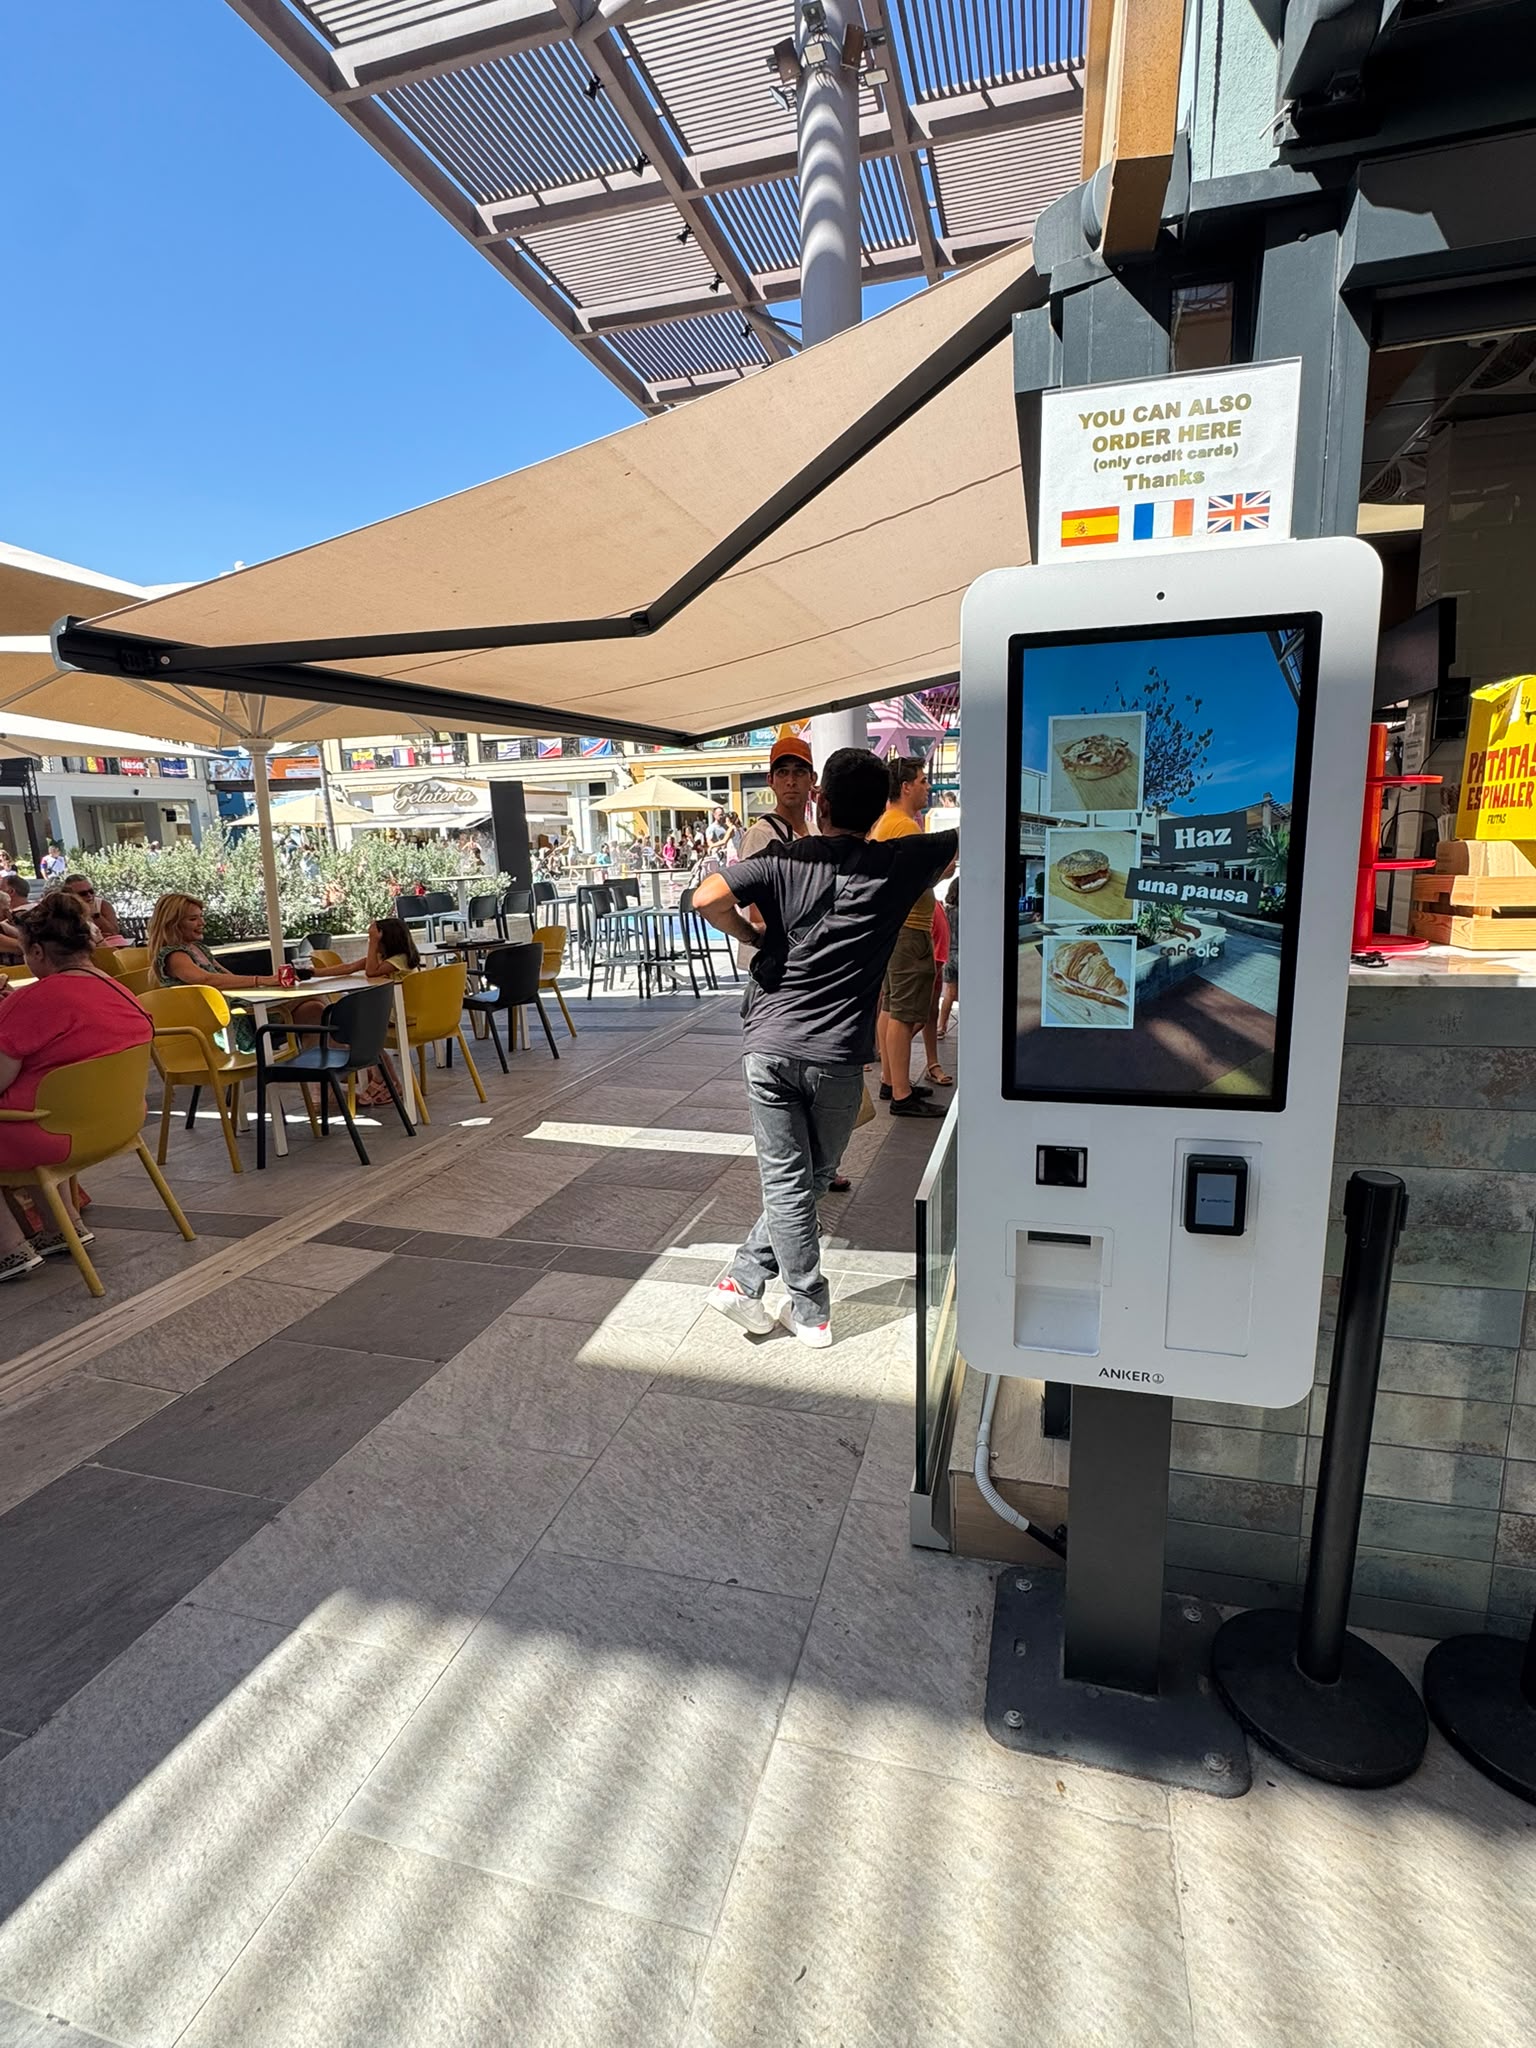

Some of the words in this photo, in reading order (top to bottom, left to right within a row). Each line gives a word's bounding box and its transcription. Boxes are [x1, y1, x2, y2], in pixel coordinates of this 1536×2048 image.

[1078, 408, 1125, 430] YOU
[1133, 401, 1181, 423] CAN
[1188, 393, 1252, 416] ALSO
[1092, 428, 1170, 453] ORDER
[1178, 419, 1242, 443] HERE
[1093, 456, 1131, 472] (only
[1135, 448, 1183, 466] credit
[1187, 442, 1239, 460] cards)
[1123, 468, 1205, 491] Thanks
[394, 782, 475, 810] Gelateria
[1466, 781, 1535, 811] ESPINALER
[1174, 827, 1232, 849] Haz
[1137, 878, 1178, 896] una
[1180, 885, 1249, 904] pausa
[1098, 1367, 1151, 1383] ANKER
